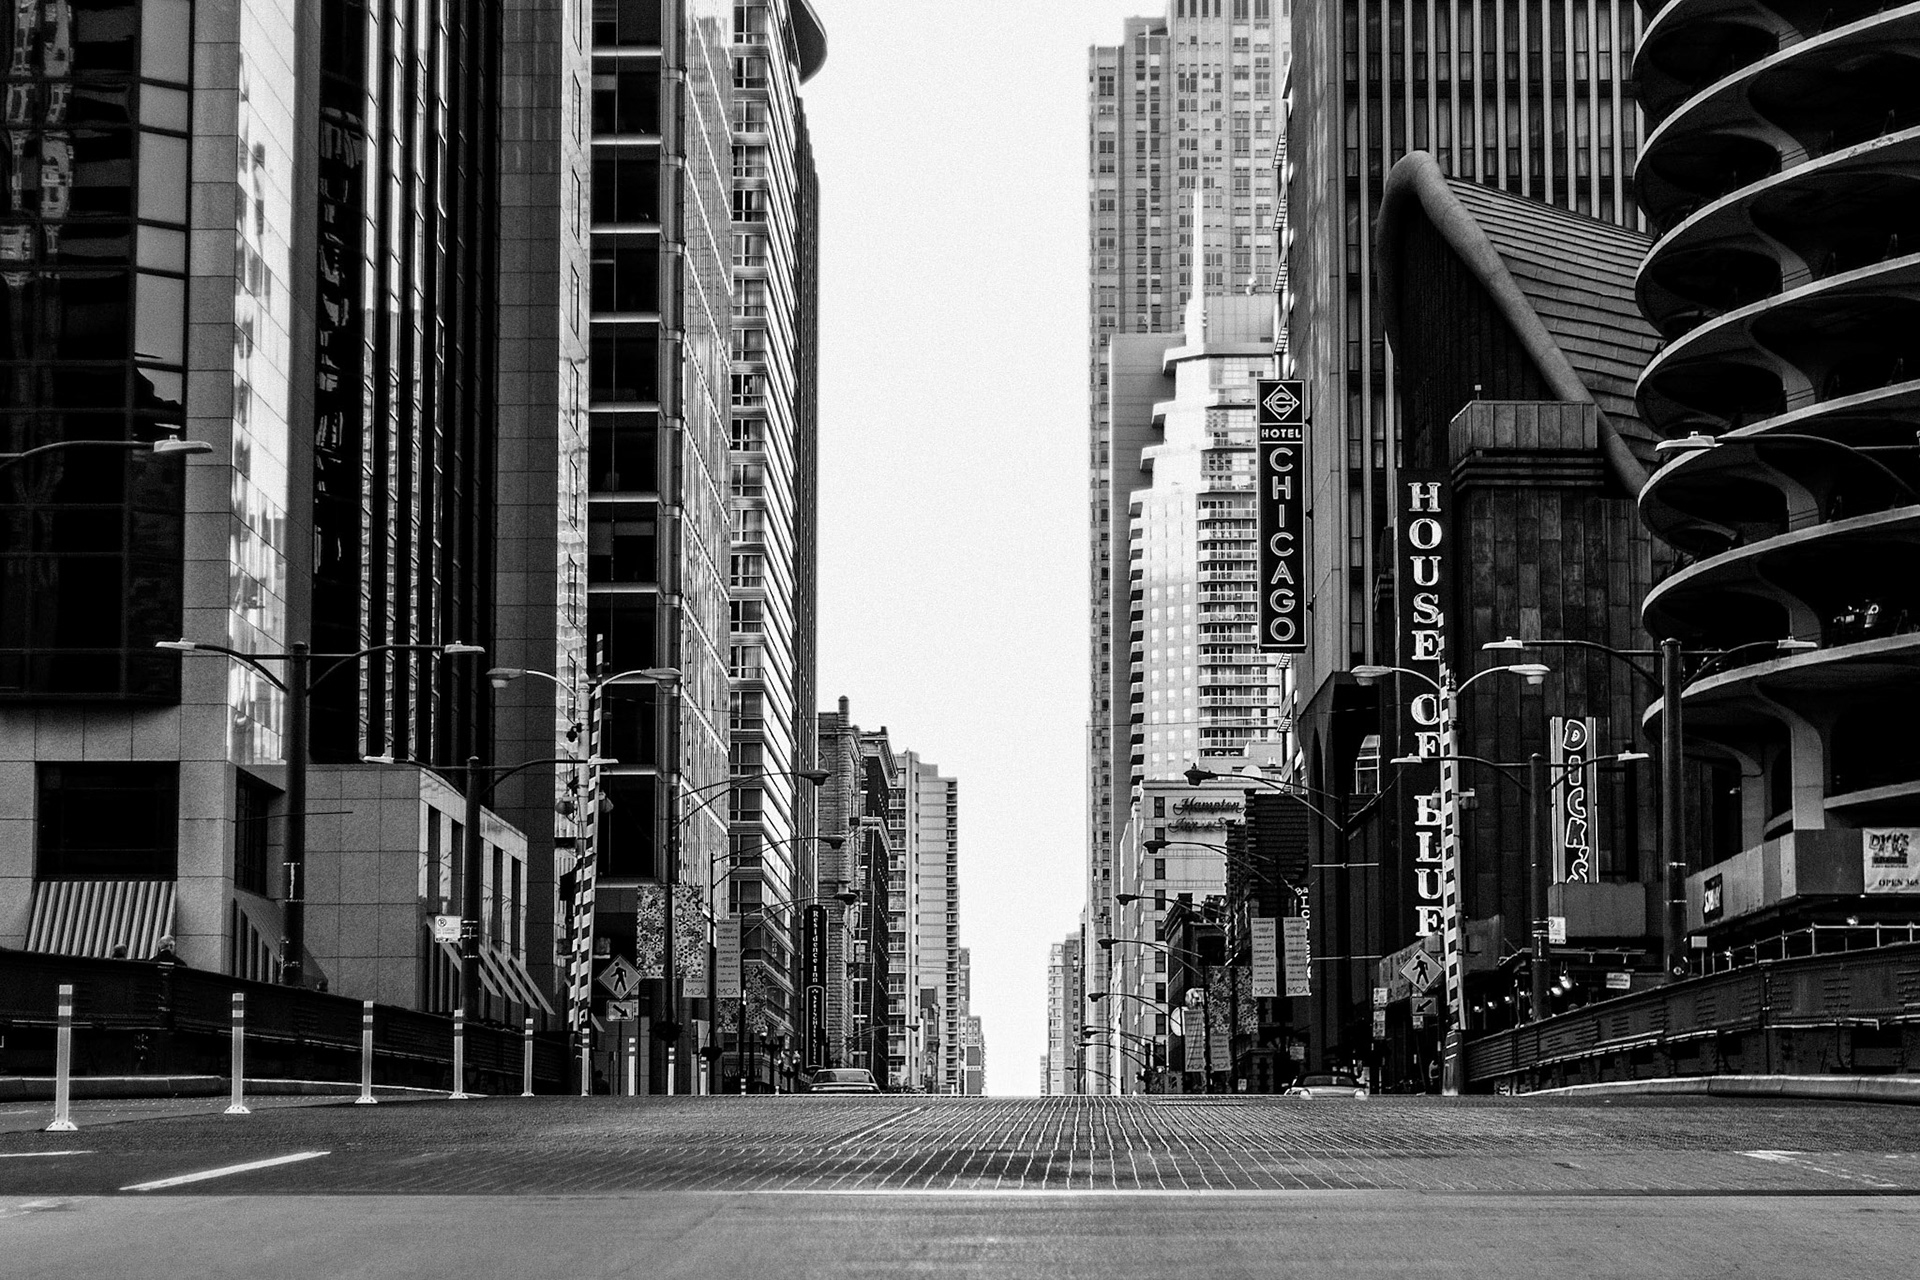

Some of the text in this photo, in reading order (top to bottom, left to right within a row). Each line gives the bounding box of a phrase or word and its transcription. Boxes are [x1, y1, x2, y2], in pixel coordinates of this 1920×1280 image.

[1261, 428, 1302, 439] HOTEL
[1269, 447, 1296, 642] CHICAGO
[1408, 482, 1442, 660] HOUSE
[1411, 693, 1440, 758] OF
[1173, 796, 1245, 815] Hampton
[1563, 719, 1589, 883] DICK'S
[1879, 879, 1903, 887] OPEN
